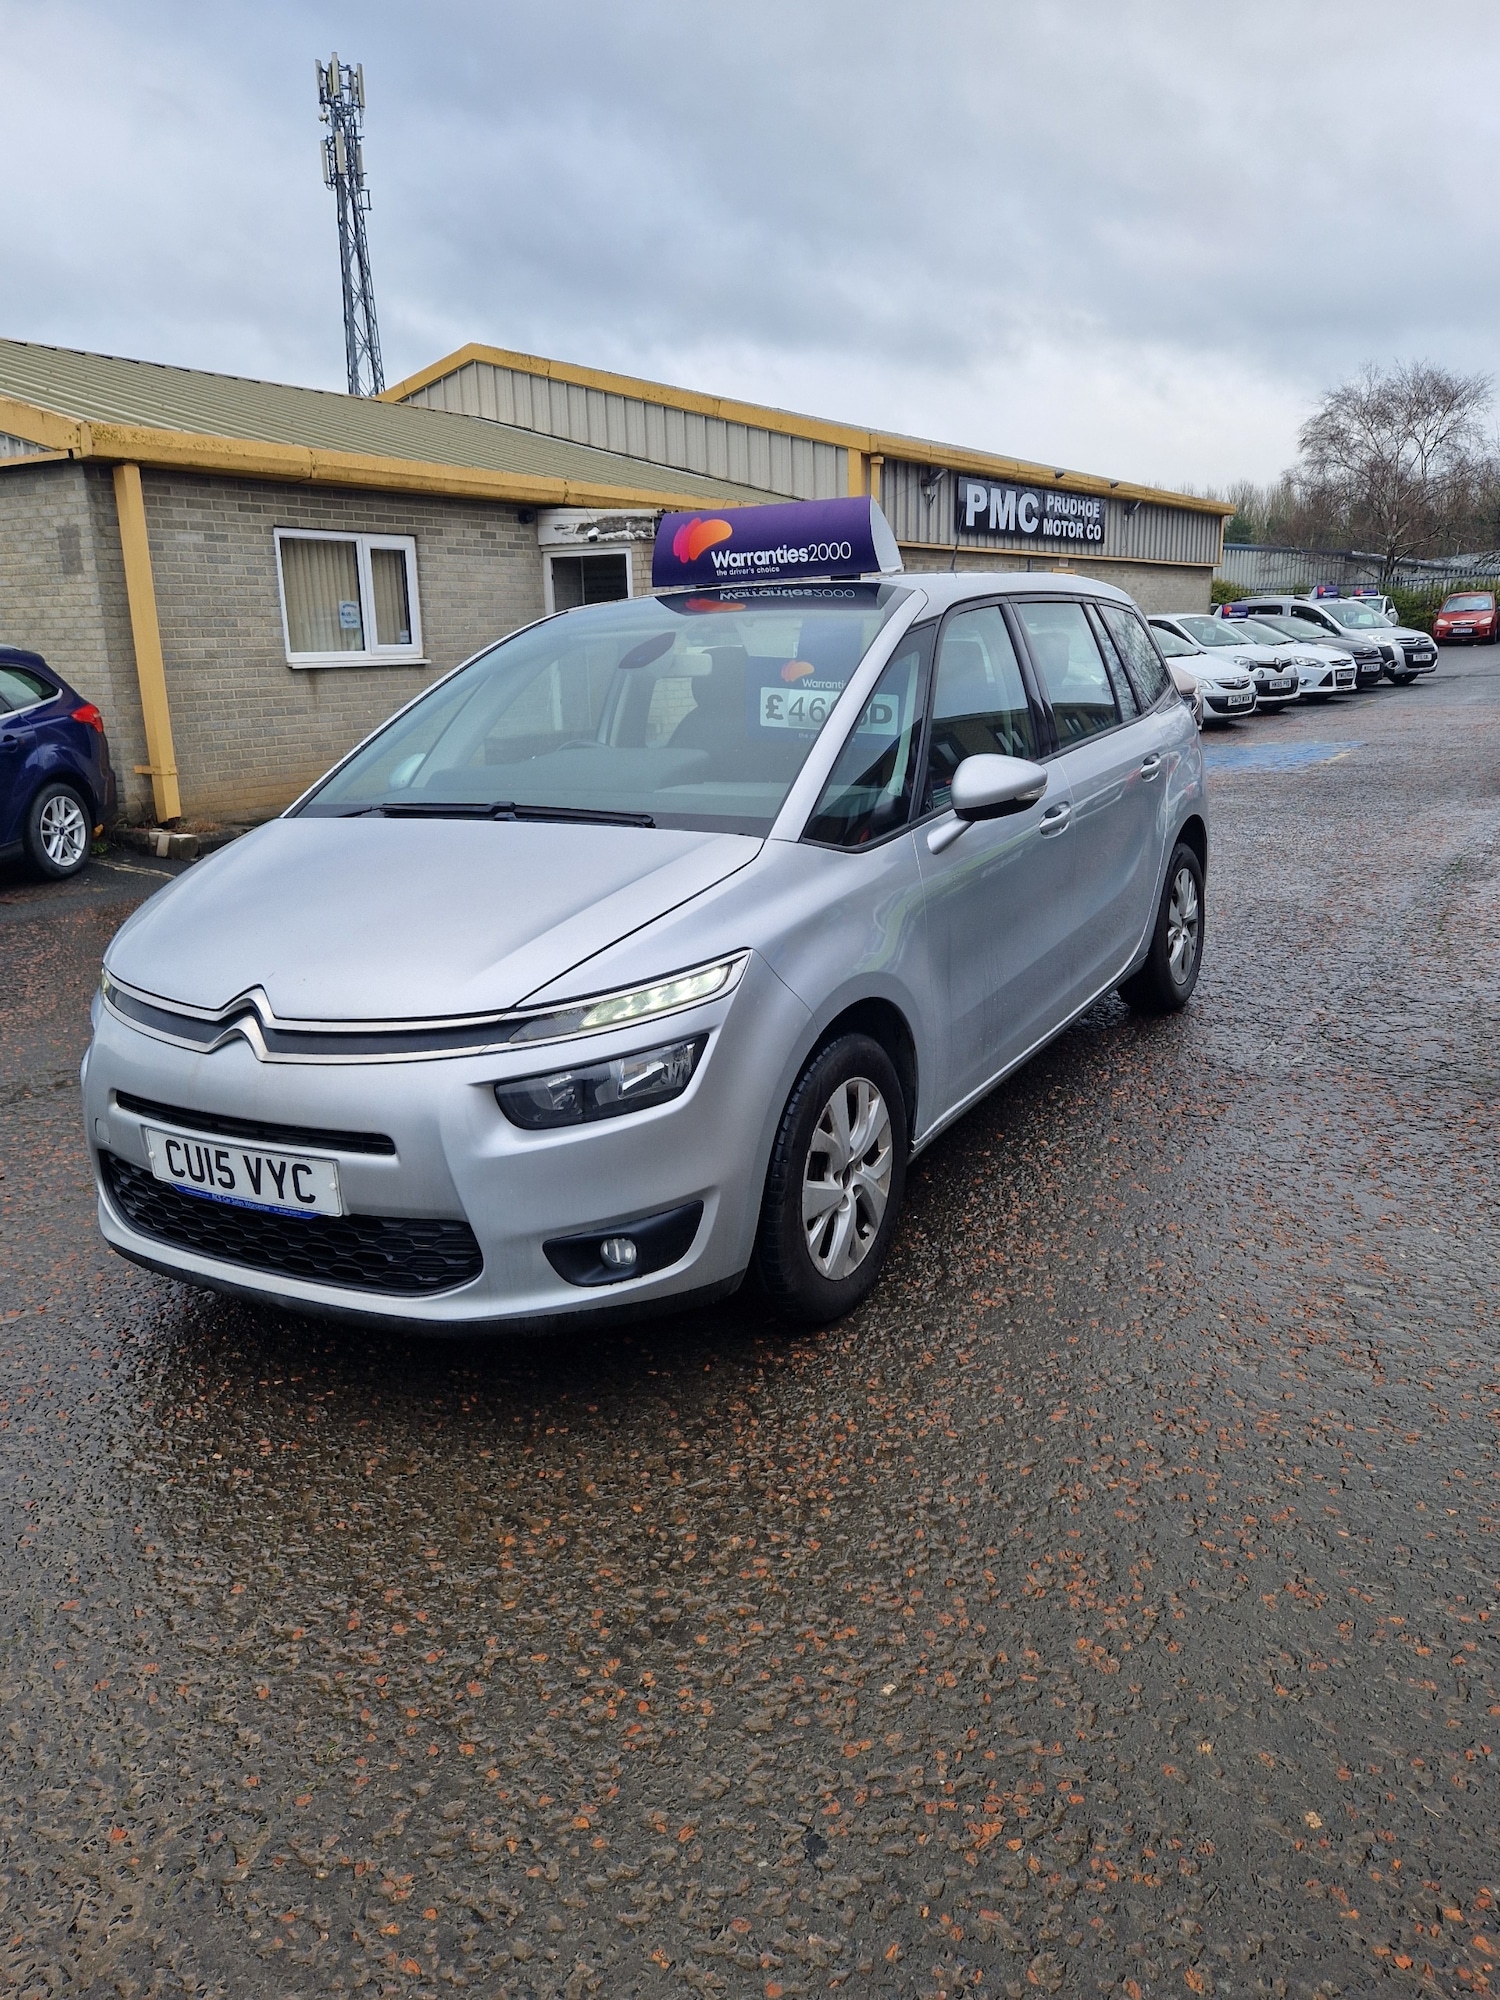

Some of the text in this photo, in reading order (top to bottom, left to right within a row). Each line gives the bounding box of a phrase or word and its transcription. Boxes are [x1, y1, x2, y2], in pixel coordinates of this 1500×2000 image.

[966, 483, 1039, 533] PMC
[1046, 494, 1100, 518] PRUDHOE
[1042, 518, 1101, 541] MOTOR CO
[711, 541, 852, 568] Warranties2000
[716, 566, 780, 577] the driver's choice
[802, 678, 847, 690] Warranti
[165, 1139, 316, 1204] CU15 VYC
